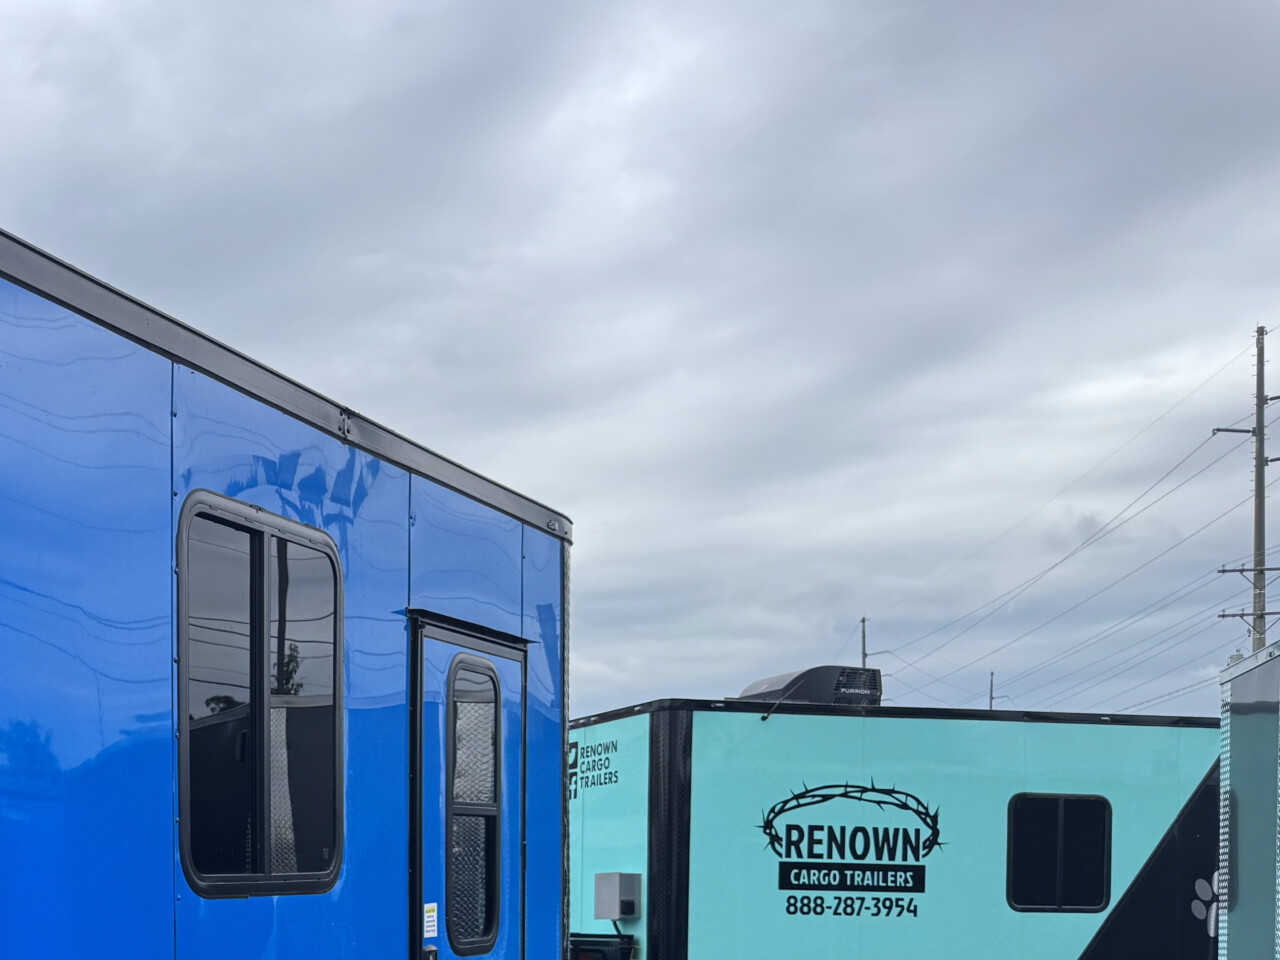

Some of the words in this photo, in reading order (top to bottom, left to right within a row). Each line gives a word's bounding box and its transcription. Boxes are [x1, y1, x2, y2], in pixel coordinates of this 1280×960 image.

[840, 687, 871, 695] FURRION
[580, 739, 618, 760] RENOWN
[579, 756, 610, 774] CARGO
[579, 770, 619, 789] TRAILERS
[784, 824, 921, 862] RENOWN
[789, 868, 840, 886] CARGO
[844, 869, 914, 887] TRAILERS
[785, 895, 918, 917] 888-287-3954
